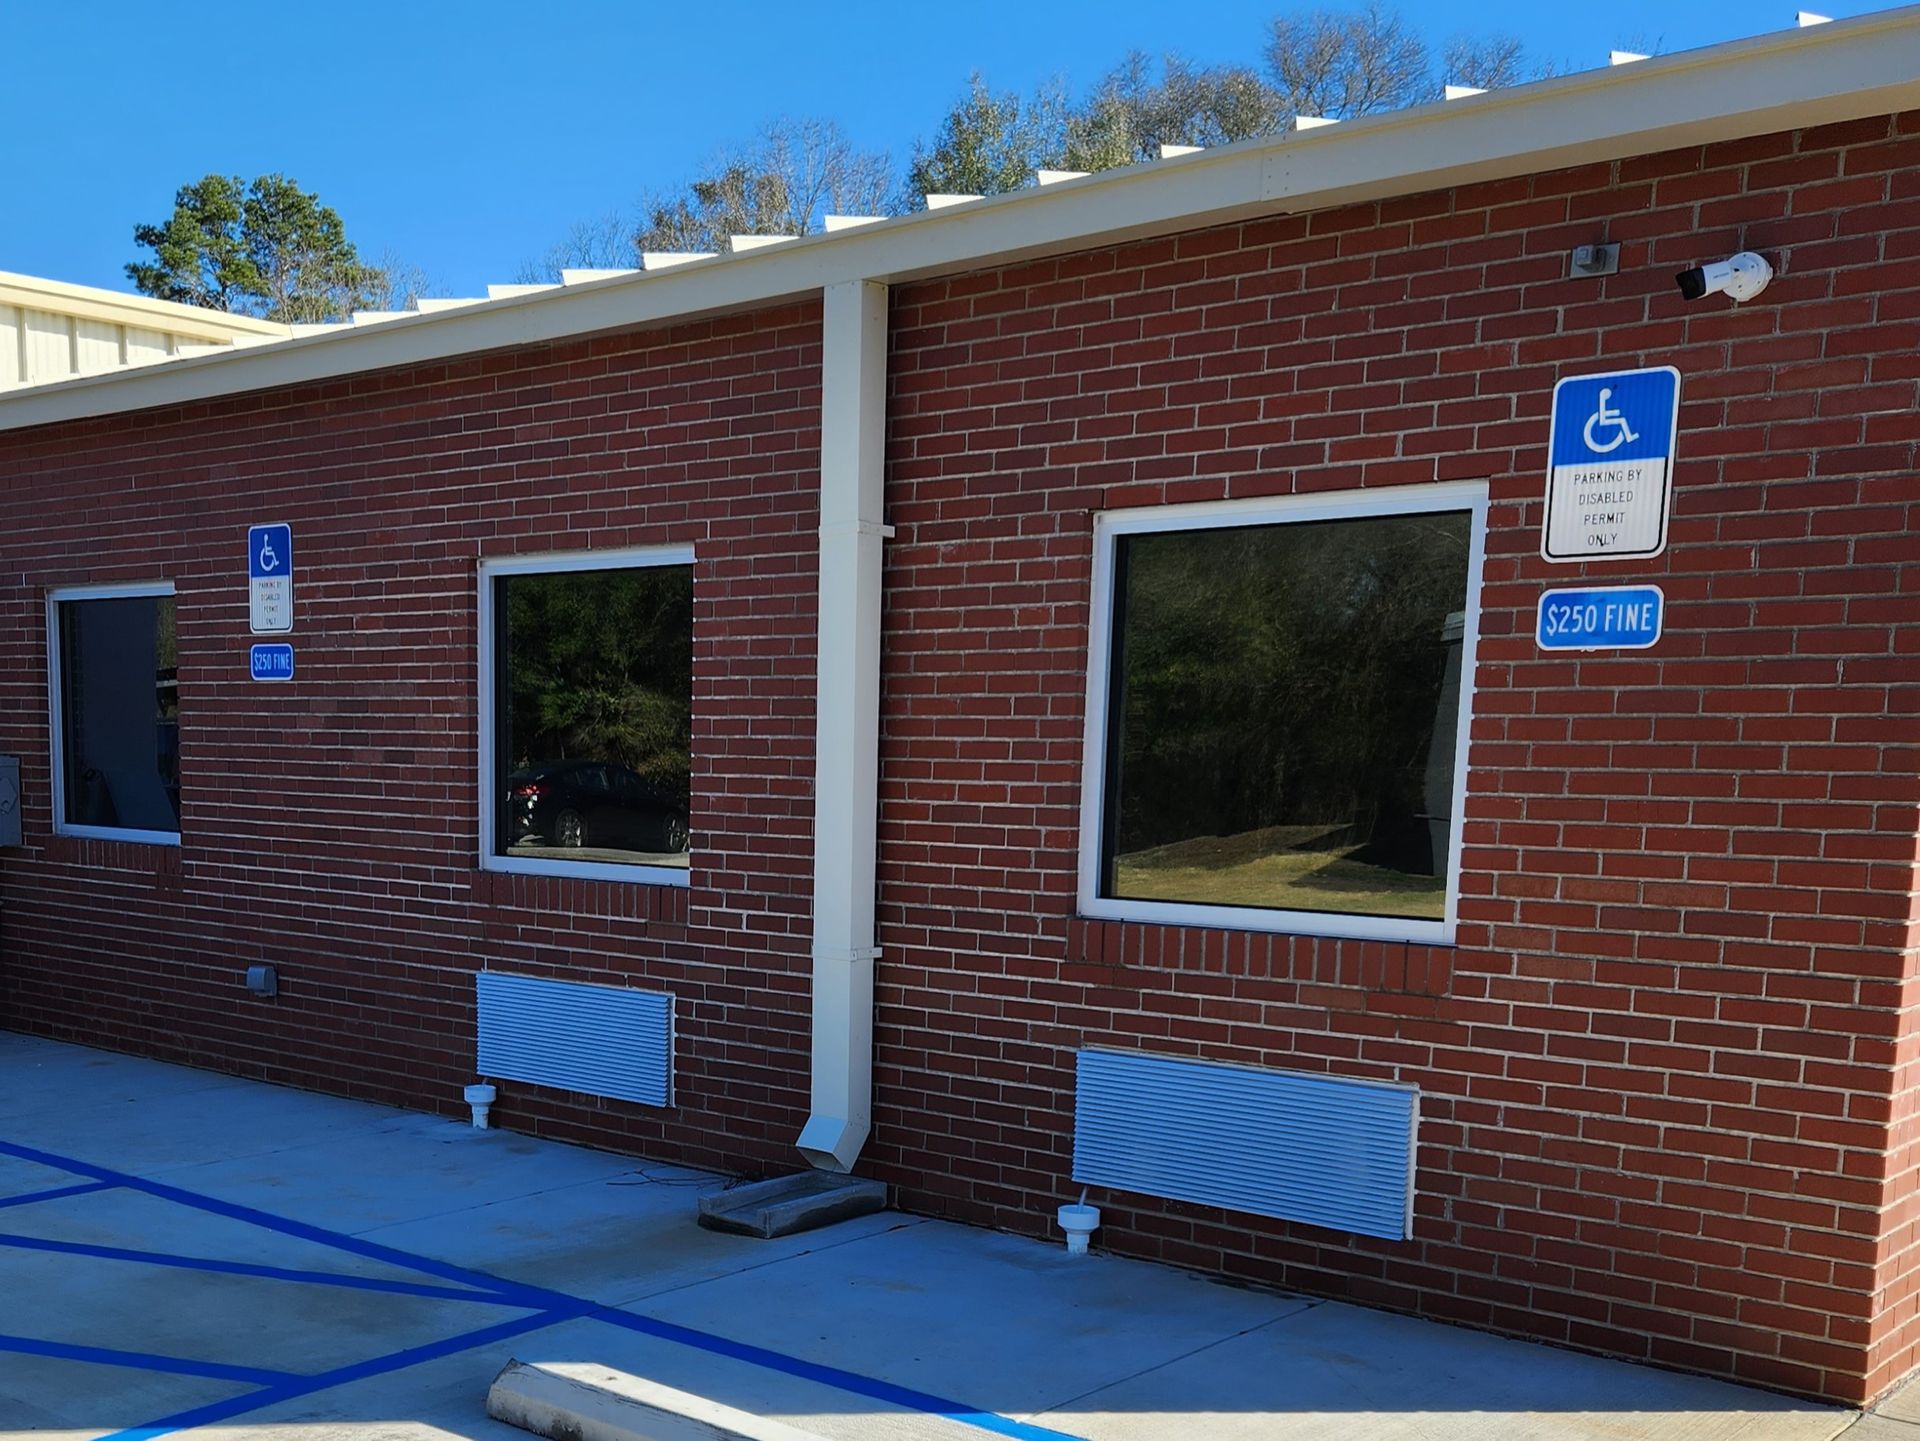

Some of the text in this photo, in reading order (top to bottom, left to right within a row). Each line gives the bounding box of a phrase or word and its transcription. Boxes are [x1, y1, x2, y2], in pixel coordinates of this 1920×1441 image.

[1574, 469, 1642, 485] PARKING BY
[1579, 491, 1633, 505] DISABLED
[1584, 512, 1626, 525] PERMIT
[1587, 533, 1618, 547] ONLY
[1546, 602, 1654, 637] $250 FINE
[254, 652, 290, 671] $250 FINE
